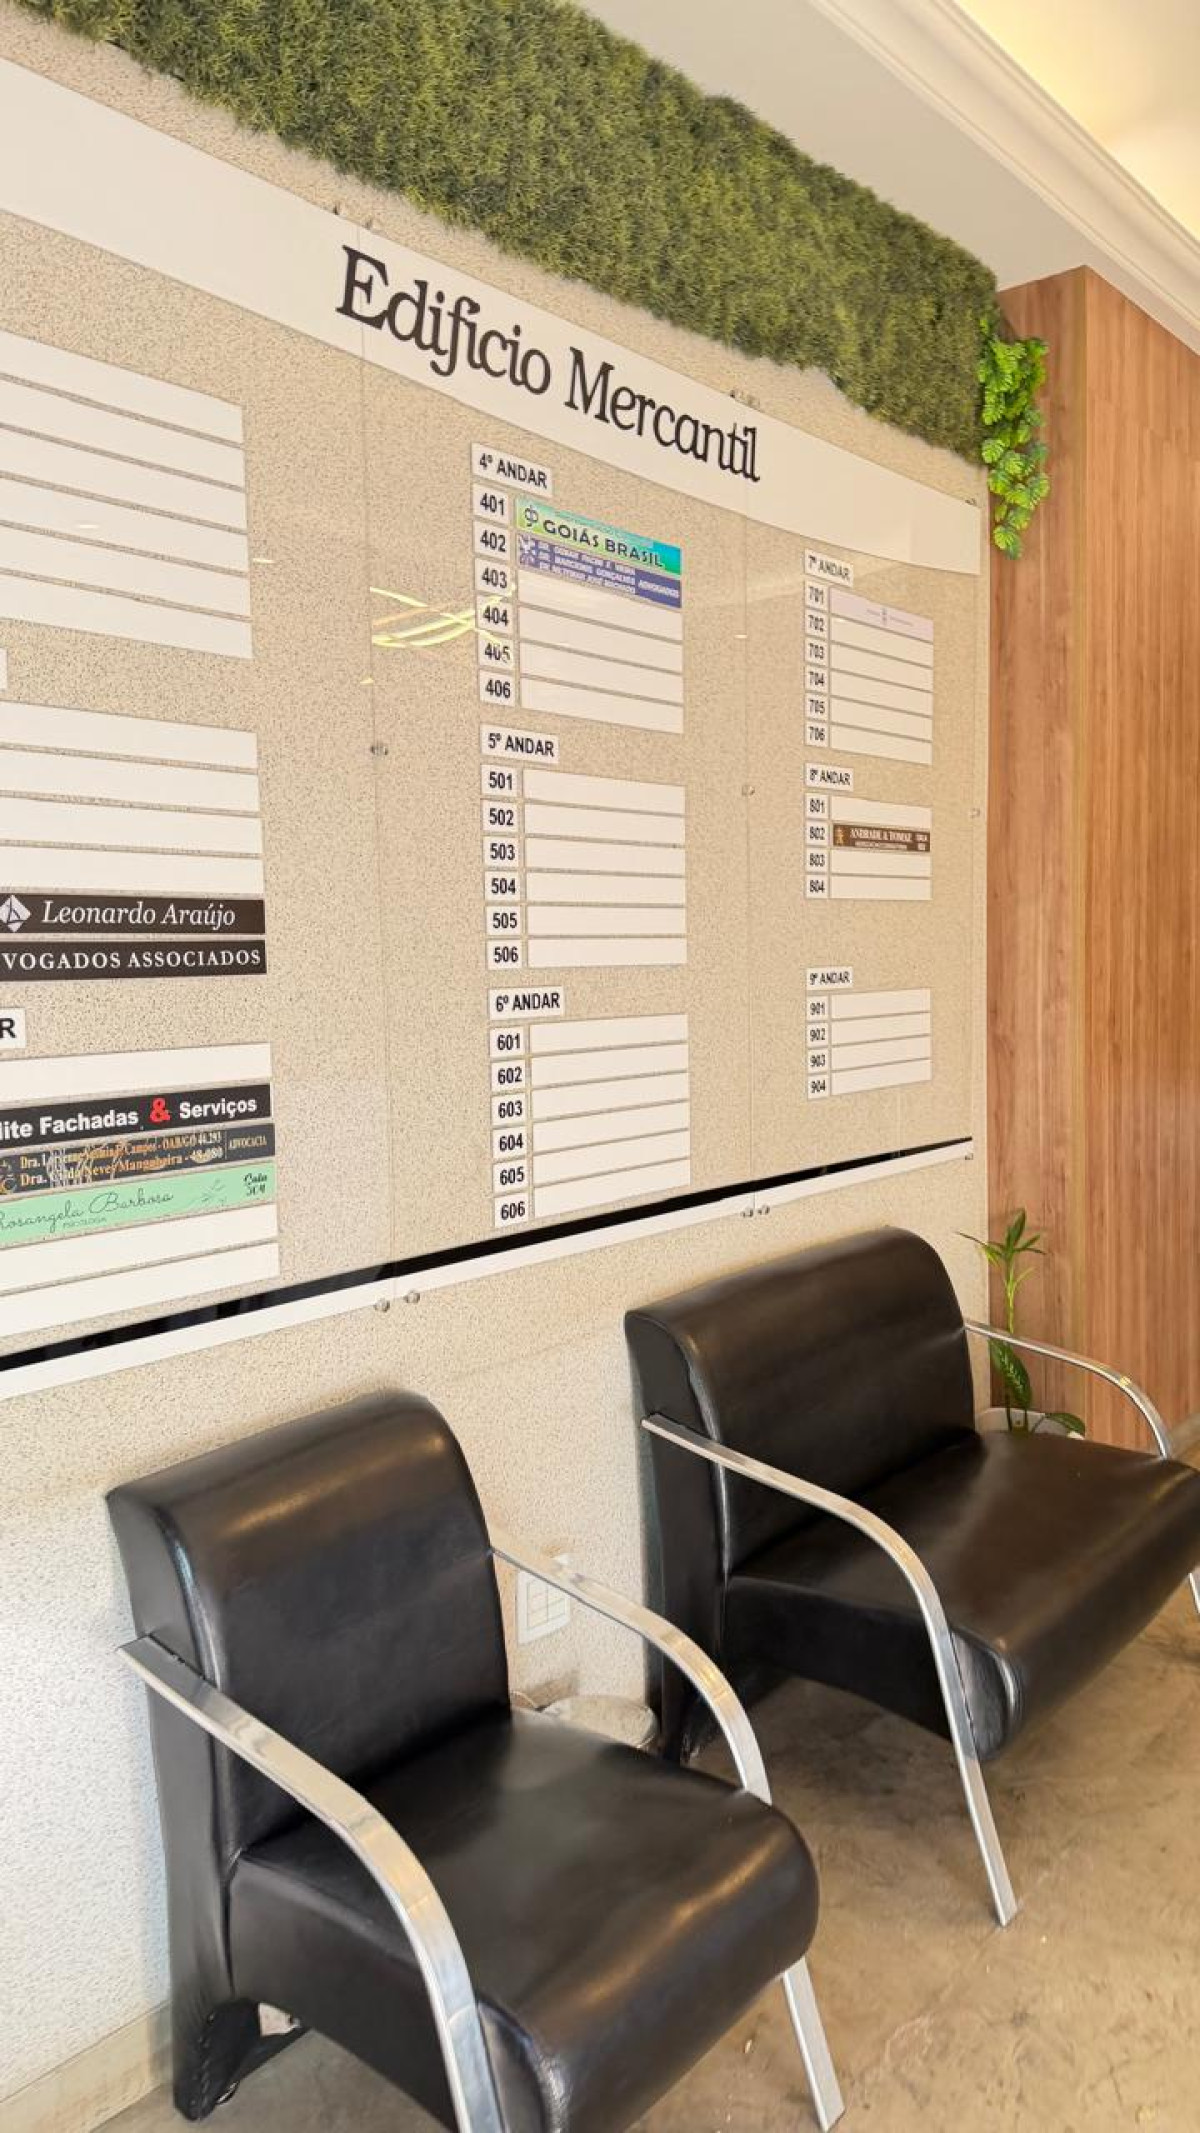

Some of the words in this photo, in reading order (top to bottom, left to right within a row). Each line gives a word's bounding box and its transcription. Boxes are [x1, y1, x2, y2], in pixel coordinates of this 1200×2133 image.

[335, 244, 551, 395] Edificio
[564, 346, 760, 482] Mercantil
[480, 452, 493, 470] 4º
[497, 459, 547, 489] ANDAR
[480, 492, 504, 516] 401
[480, 529, 506, 552] 402
[543, 519, 599, 547] GOIÁS
[604, 537, 663, 567] BRASIL
[481, 566, 508, 589] 403
[819, 559, 850, 582] ANDAR
[809, 586, 824, 605] 701
[483, 605, 509, 626] 404
[808, 614, 824, 632] 702
[484, 642, 511, 663] 405
[809, 642, 824, 660] 703
[809, 671, 824, 687] 704
[486, 679, 511, 698] 406
[809, 699, 825, 714] 705
[809, 726, 825, 741] 706
[488, 732, 502, 748] 5º
[505, 735, 554, 757] ANDAR
[488, 771, 513, 790] 501
[820, 770, 850, 785] ANDAR
[810, 797, 824, 813] 801
[489, 808, 514, 827] 502
[810, 826, 825, 840] 802
[490, 843, 515, 861] 503
[810, 853, 825, 867] 803
[491, 878, 516, 895] 504
[810, 880, 825, 893] 804
[42, 901, 156, 924] Leonardo
[161, 903, 236, 930] Araújo
[492, 913, 518, 929] 505
[2, 952, 121, 970] VOGADOS
[127, 950, 261, 968] ASSOCIADOS
[494, 946, 519, 963] 506
[820, 971, 850, 984] ANDAR
[496, 994, 509, 1012] 6º
[512, 992, 560, 1011] ANDAR
[810, 1002, 825, 1015] 901
[497, 1033, 521, 1050] 601
[810, 1028, 826, 1042] 902
[810, 1054, 826, 1067] 903
[498, 1066, 522, 1084] 602
[810, 1080, 826, 1093] 904
[39, 1110, 139, 1135] Fachadas
[150, 1098, 171, 1123] &
[179, 1098, 257, 1119] Serviços
[498, 1100, 523, 1118] 603
[499, 1133, 524, 1151] 604
[21, 1156, 40, 1168] Dra.
[21, 1173, 47, 1187] Dra.
[500, 1166, 525, 1185] 605
[88, 1188, 174, 1214] Barbosa
[501, 1202, 526, 1220] 606
